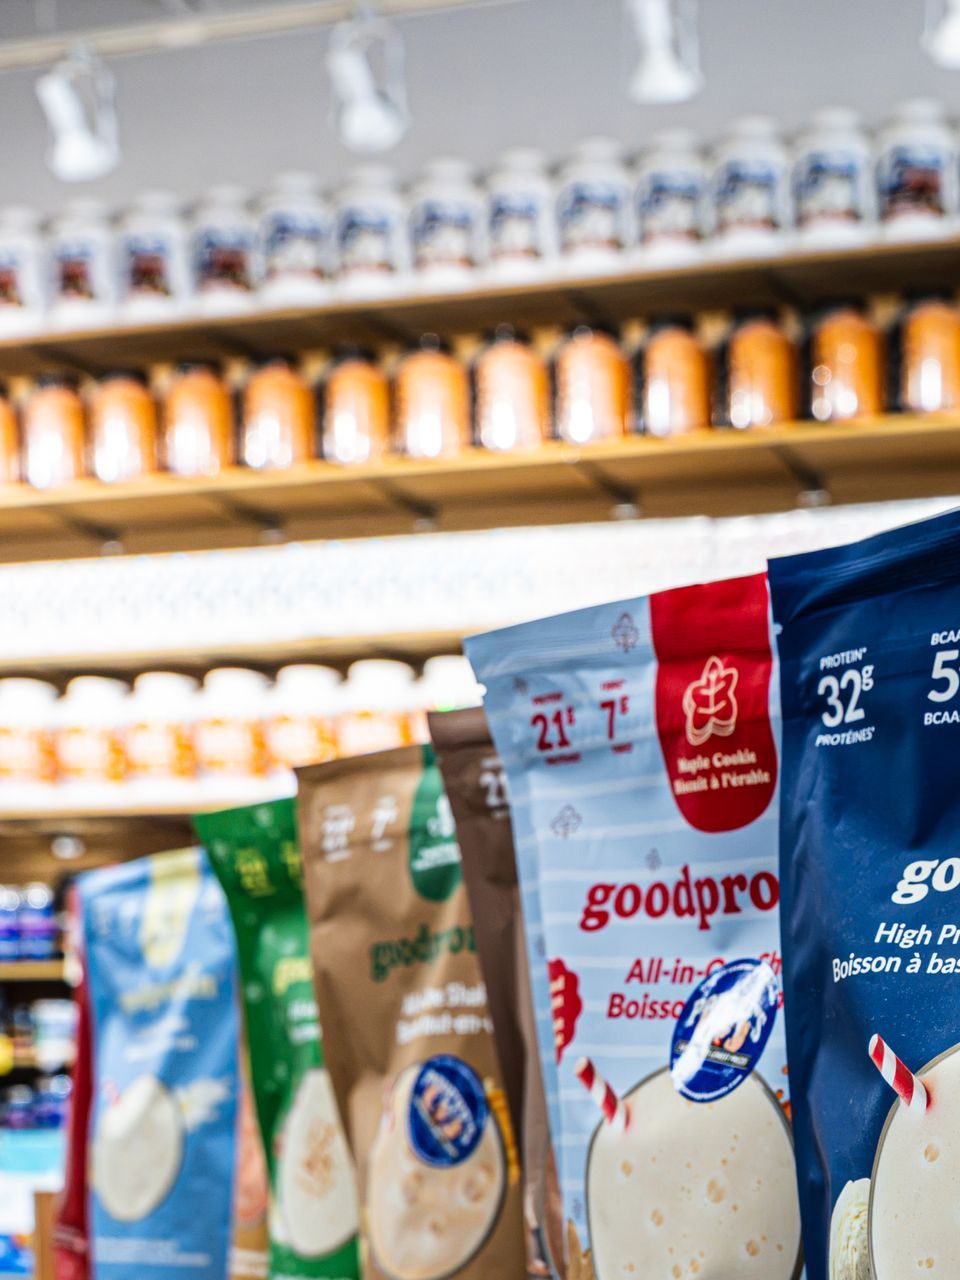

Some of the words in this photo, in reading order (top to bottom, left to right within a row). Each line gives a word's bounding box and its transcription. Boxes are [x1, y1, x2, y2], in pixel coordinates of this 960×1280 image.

[712, 748, 757, 768] Cookie
[874, 922, 932, 949] High
[832, 953, 901, 983] Boisson
[905, 953, 922, 974] à
